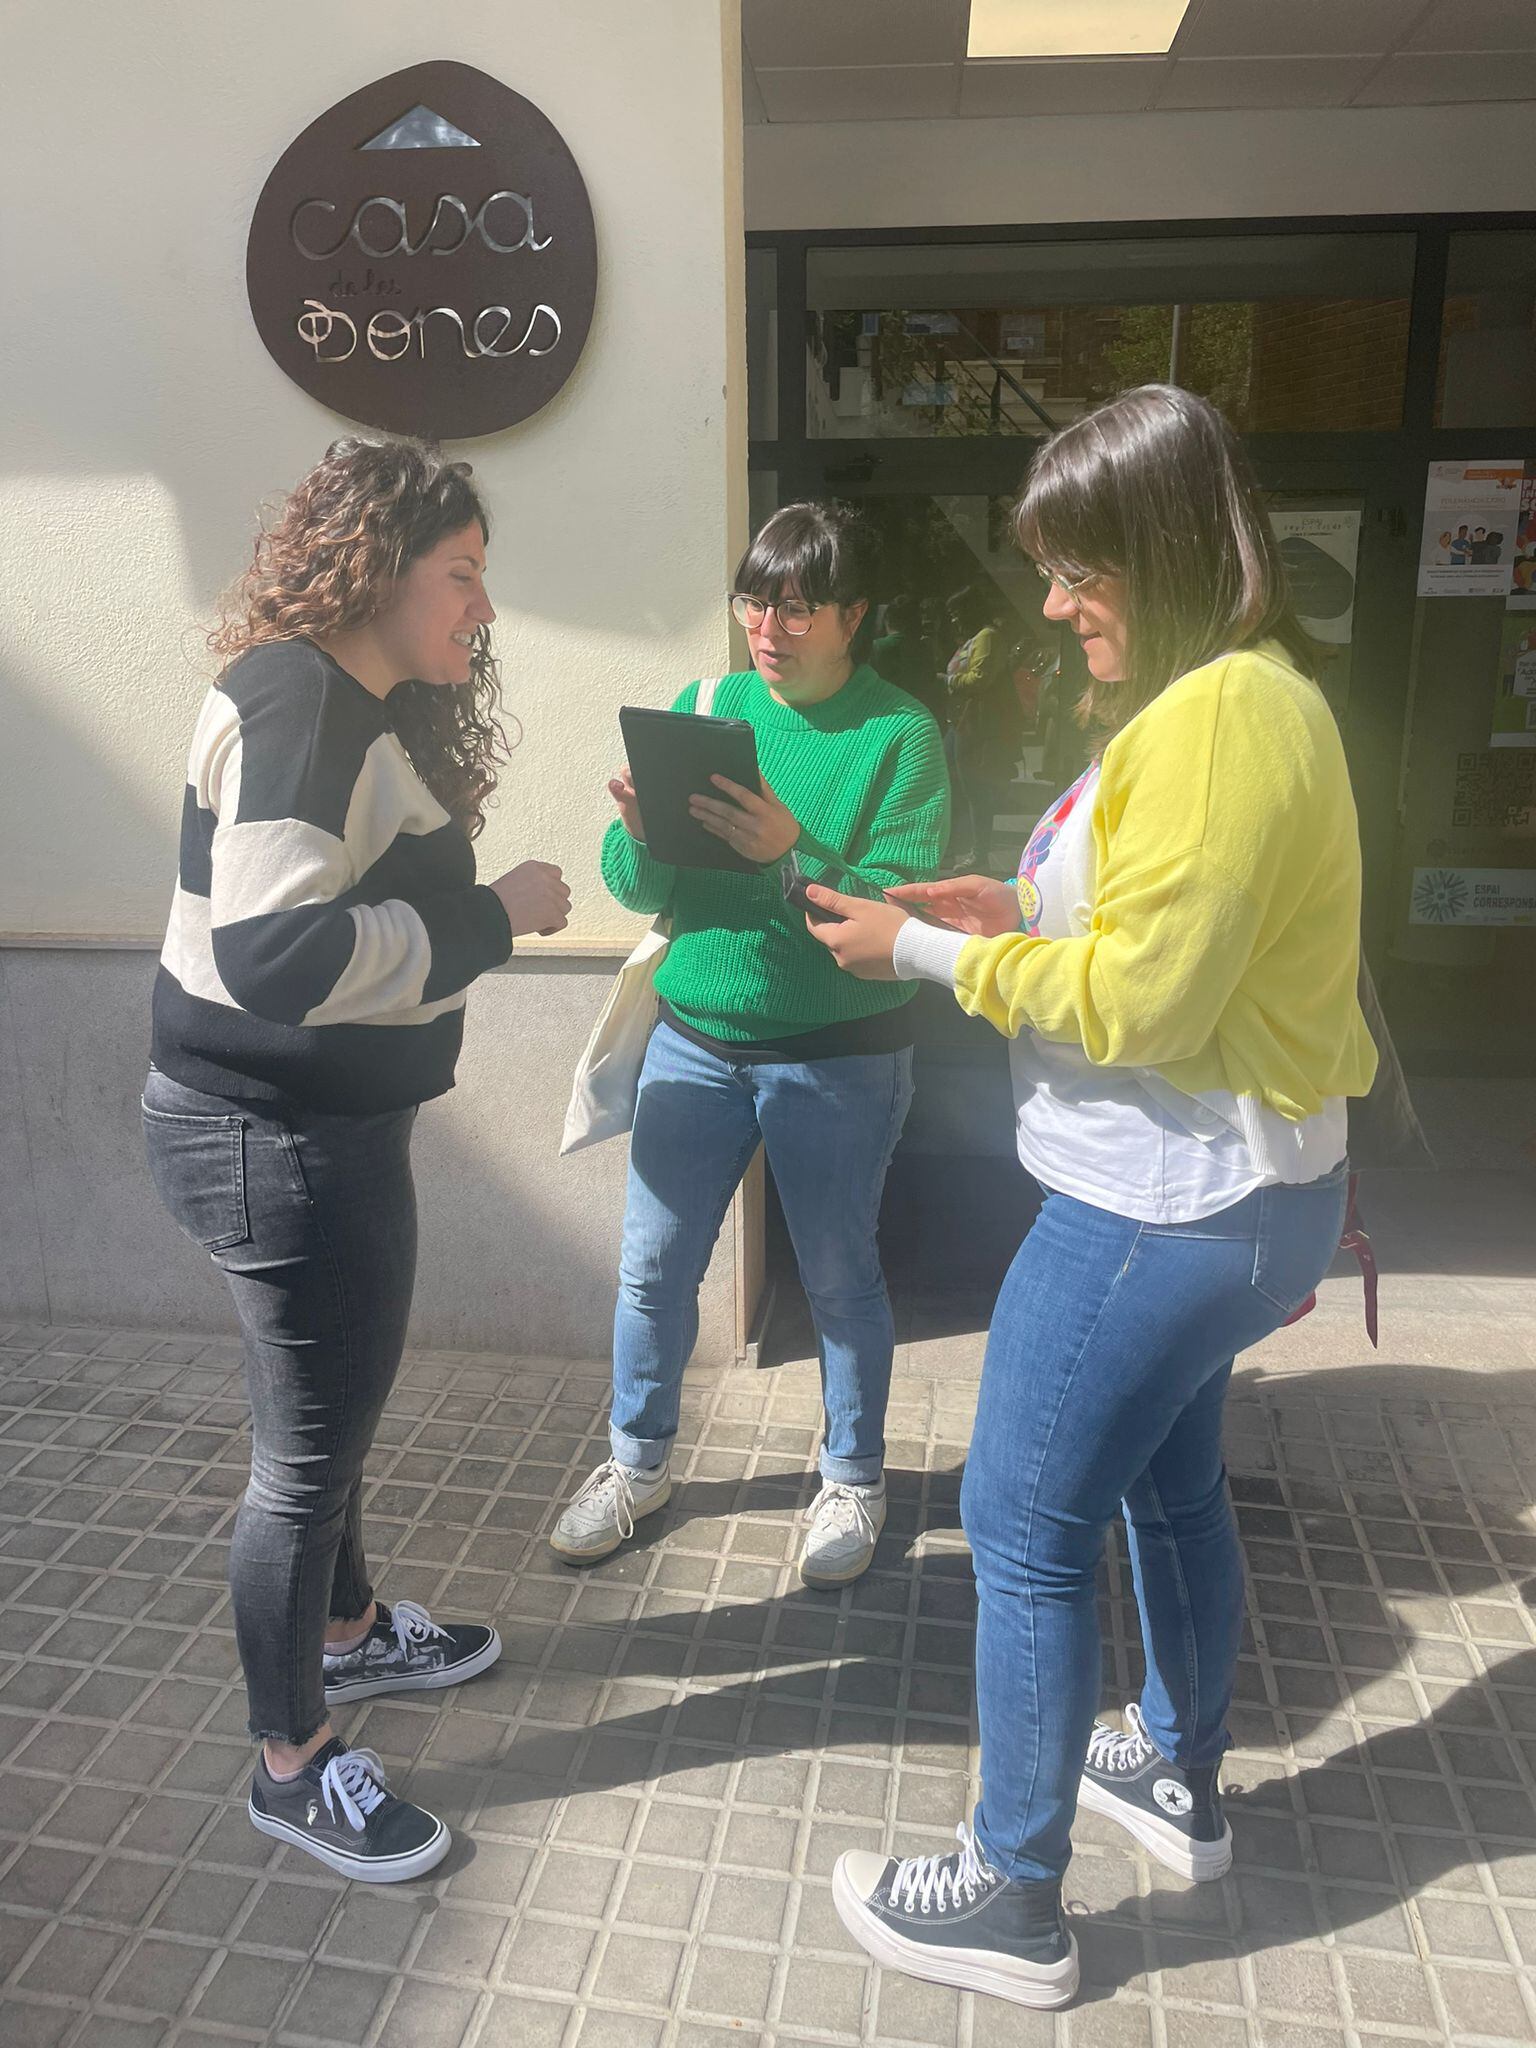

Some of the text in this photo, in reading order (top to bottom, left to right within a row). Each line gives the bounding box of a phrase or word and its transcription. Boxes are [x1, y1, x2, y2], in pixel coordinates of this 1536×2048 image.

[290, 190, 553, 261] casa
[297, 299, 562, 363] Dones
[1473, 896, 1536, 909] CORRESPONS
[1474, 884, 1500, 895] ESPAI
